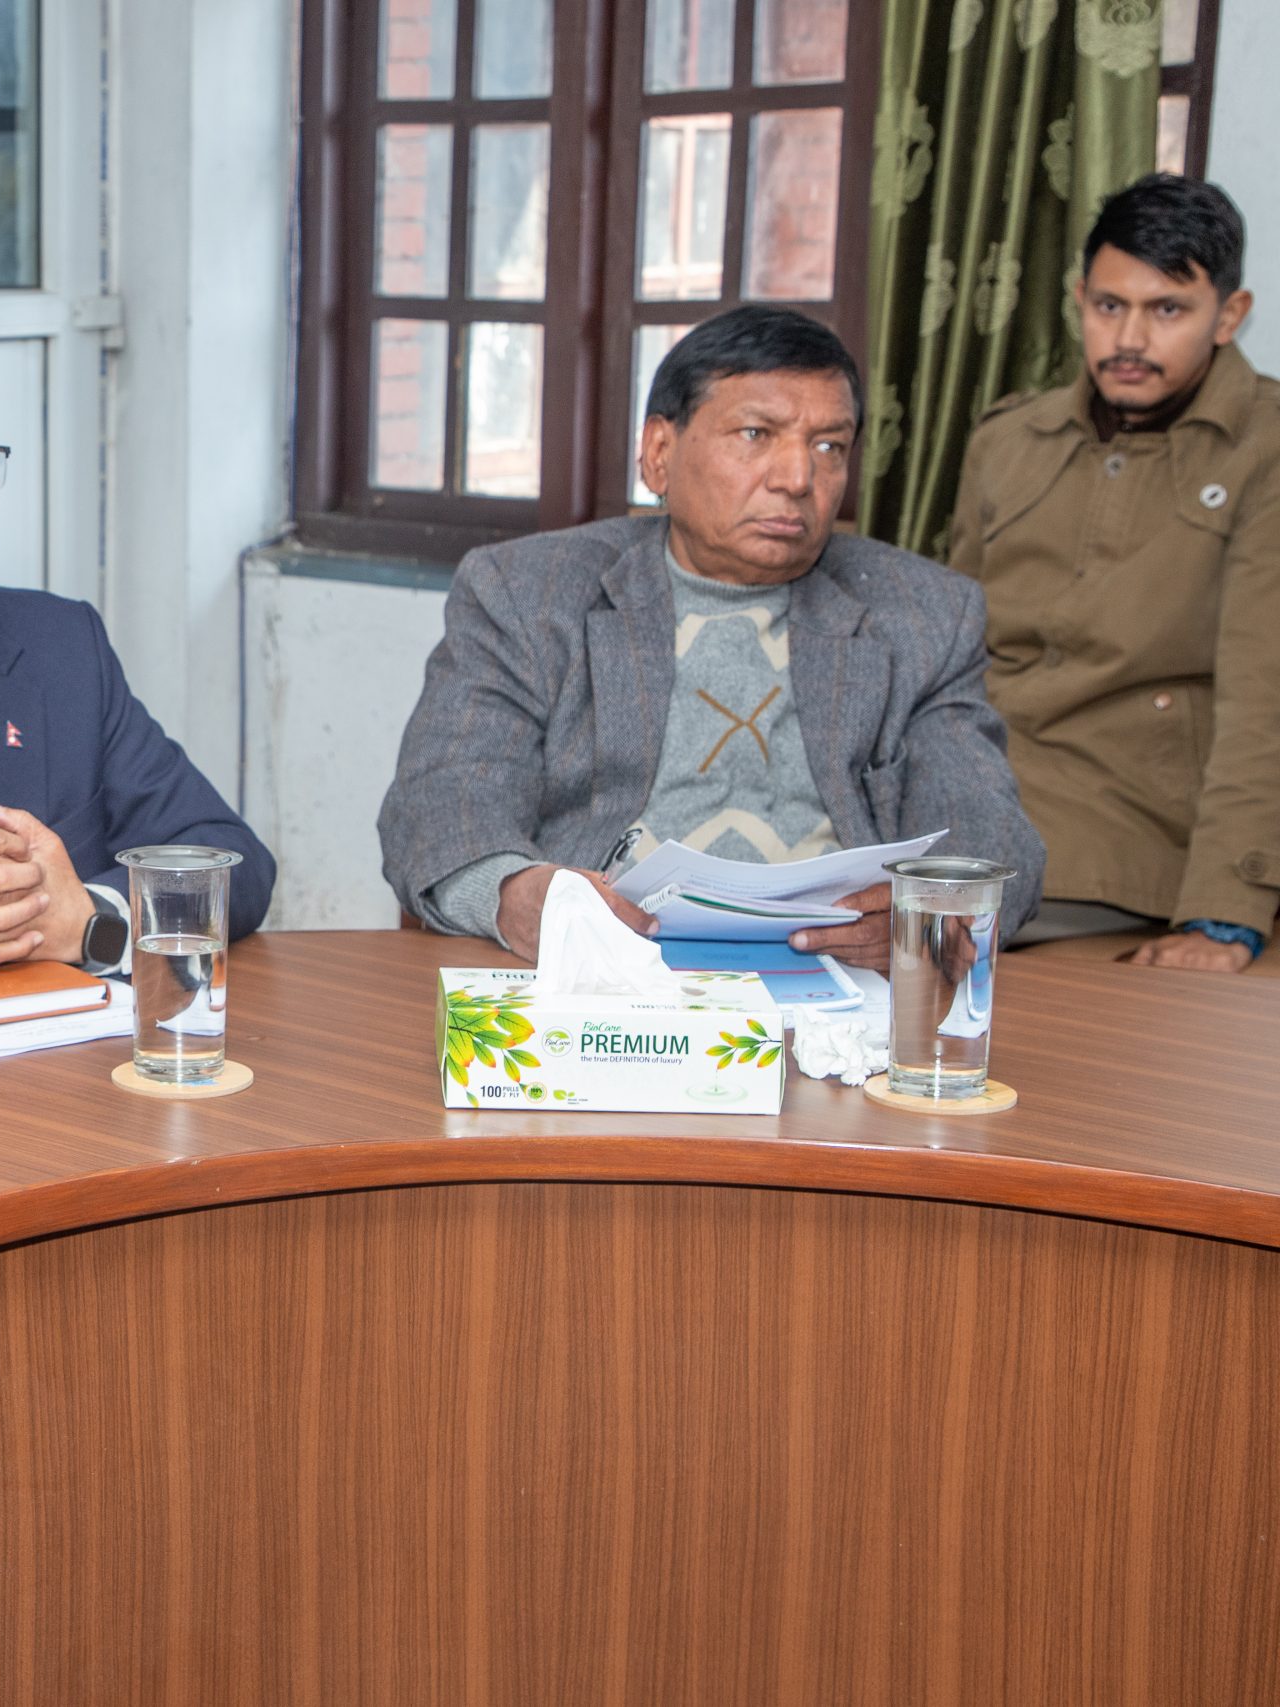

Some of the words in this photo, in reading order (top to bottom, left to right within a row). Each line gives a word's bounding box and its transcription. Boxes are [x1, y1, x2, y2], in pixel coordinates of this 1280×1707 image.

[583, 1021, 622, 1033] BioCare
[580, 1033, 689, 1055] PREMIUM
[660, 1056, 683, 1065] luxury
[480, 1085, 502, 1098] 100
